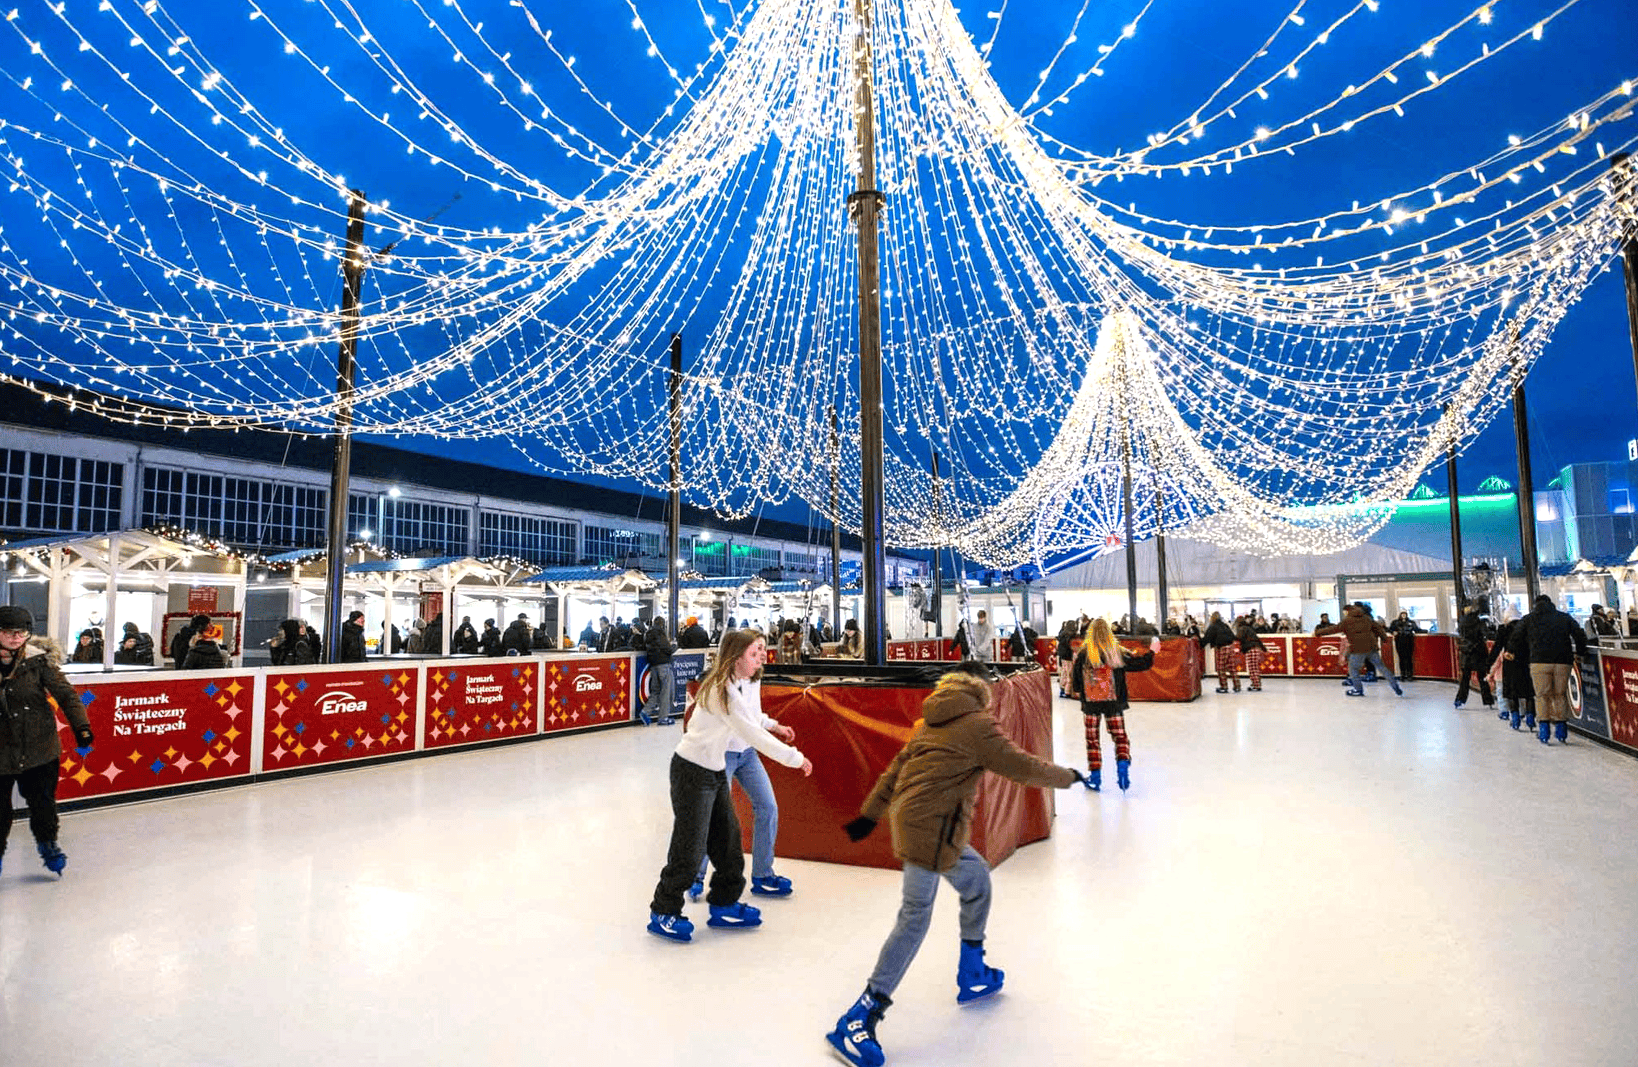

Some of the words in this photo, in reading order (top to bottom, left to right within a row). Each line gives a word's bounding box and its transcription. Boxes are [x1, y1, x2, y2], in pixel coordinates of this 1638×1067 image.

[1320, 648, 1341, 656] Ene
[466, 674, 495, 685] Jarmark
[465, 684, 504, 695] Świąteczny
[576, 680, 603, 692] Enea
[115, 693, 170, 709] Jarmark
[465, 695, 476, 705] Na
[476, 694, 504, 705] Targach
[321, 699, 368, 715] Enea
[114, 708, 188, 722] Świąteczny
[113, 724, 132, 737] Na
[134, 720, 187, 735] Targach
